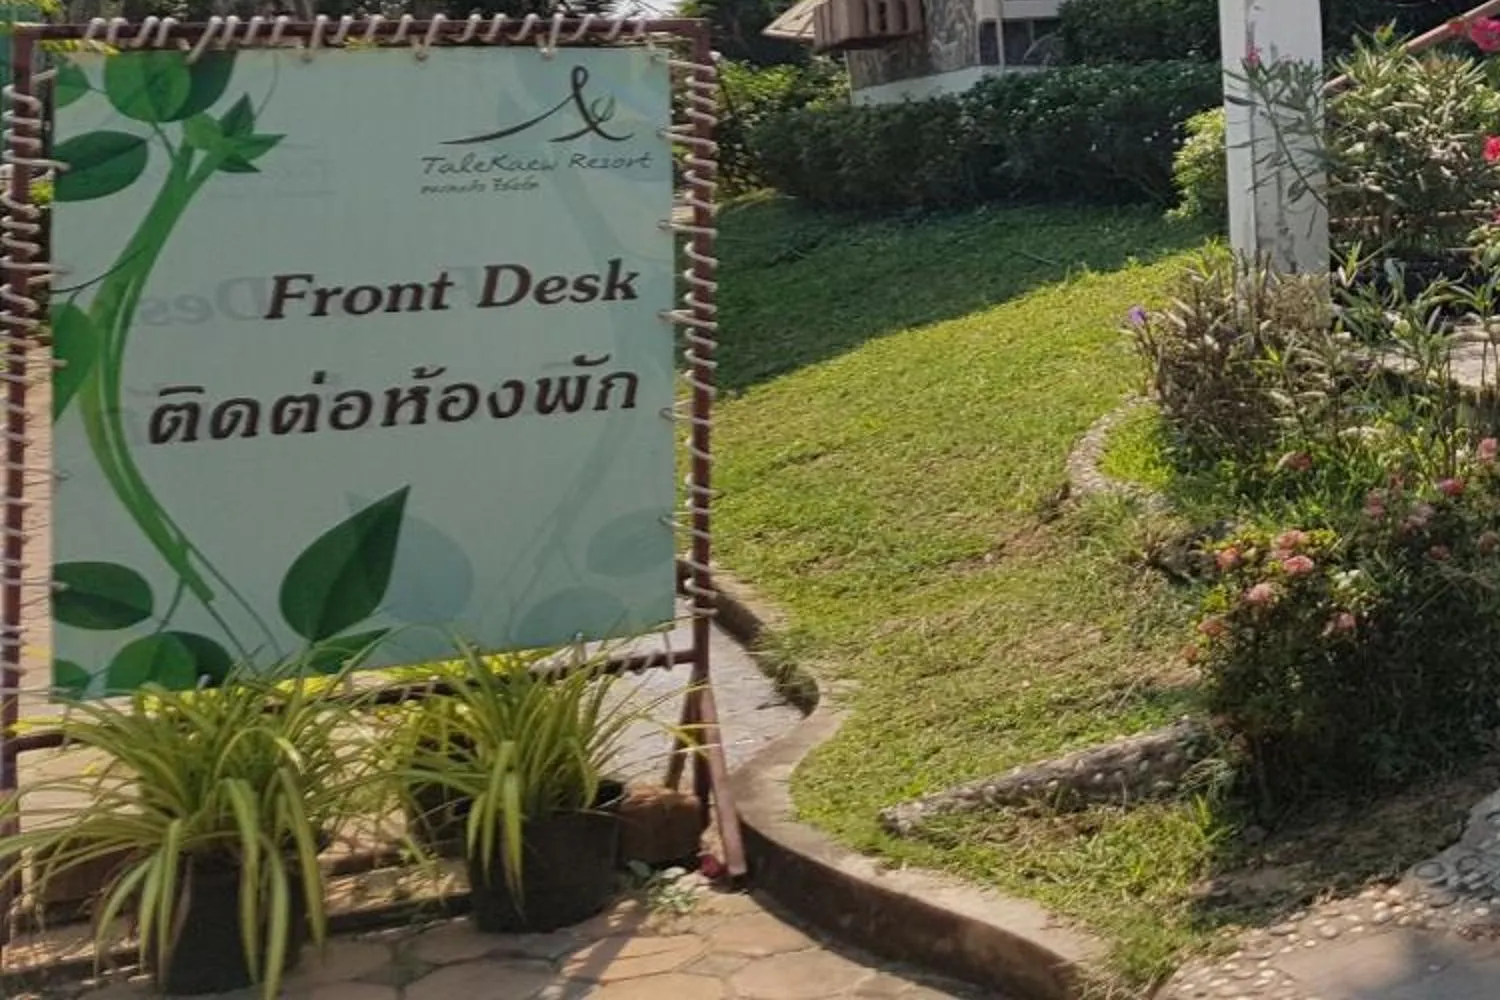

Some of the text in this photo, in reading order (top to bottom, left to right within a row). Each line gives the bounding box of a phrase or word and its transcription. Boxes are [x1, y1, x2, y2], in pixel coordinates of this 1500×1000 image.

[420, 151, 654, 175] TaleKaew Resort
[263, 257, 640, 321] Front Desk
[148, 354, 639, 446] ติดต่อห้องพัก
